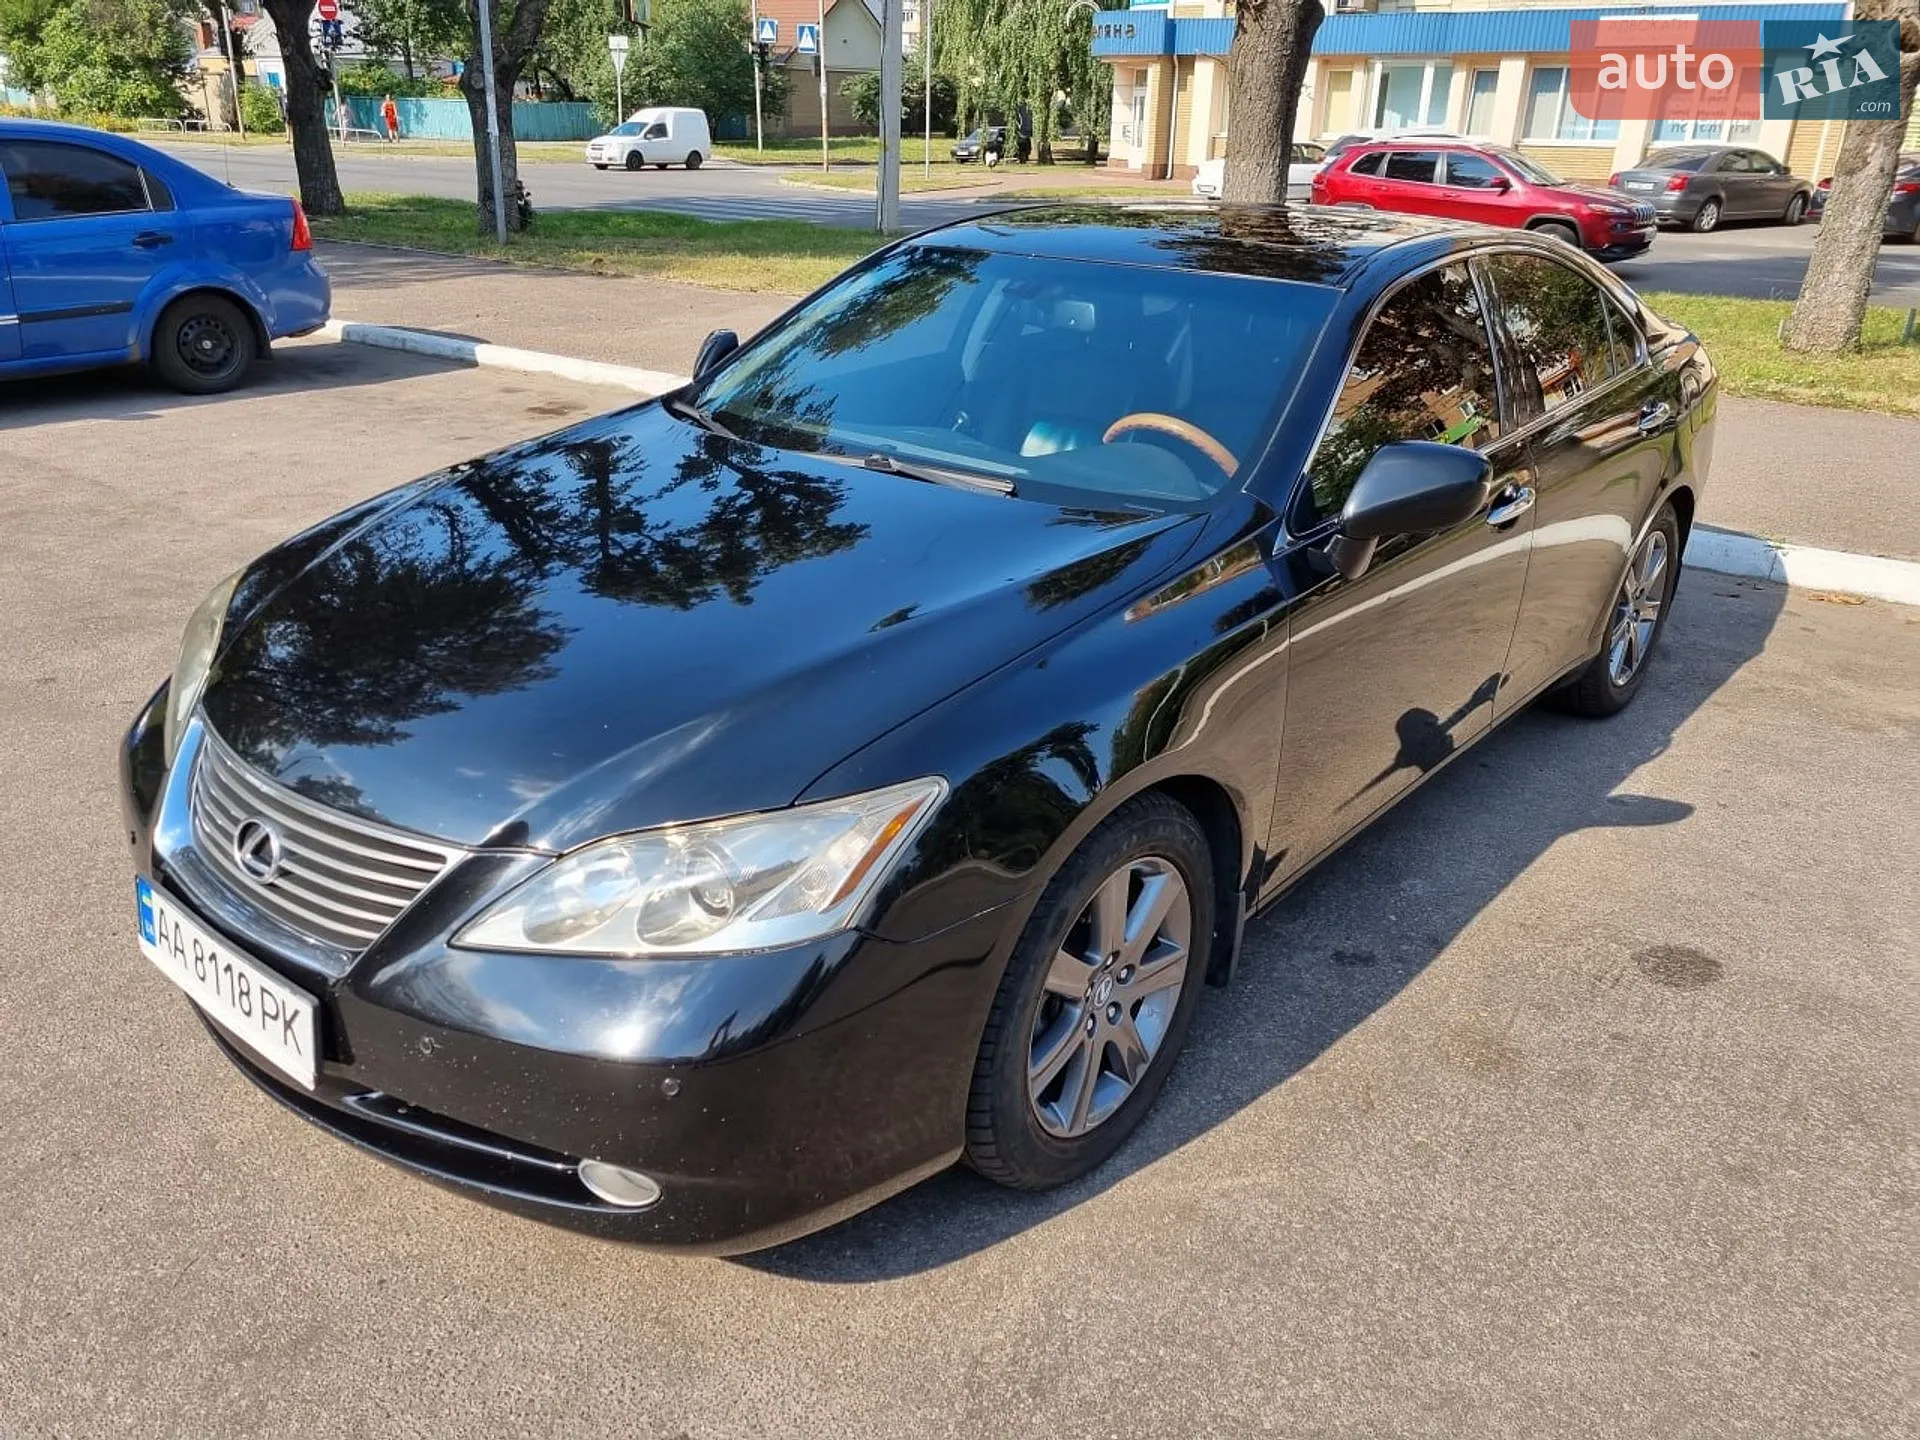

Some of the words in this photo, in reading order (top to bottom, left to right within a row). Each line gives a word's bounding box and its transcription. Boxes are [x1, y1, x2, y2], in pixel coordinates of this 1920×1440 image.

[158, 908, 188, 970] AA
[193, 938, 252, 1018] 8118
[259, 985, 302, 1057] PK
